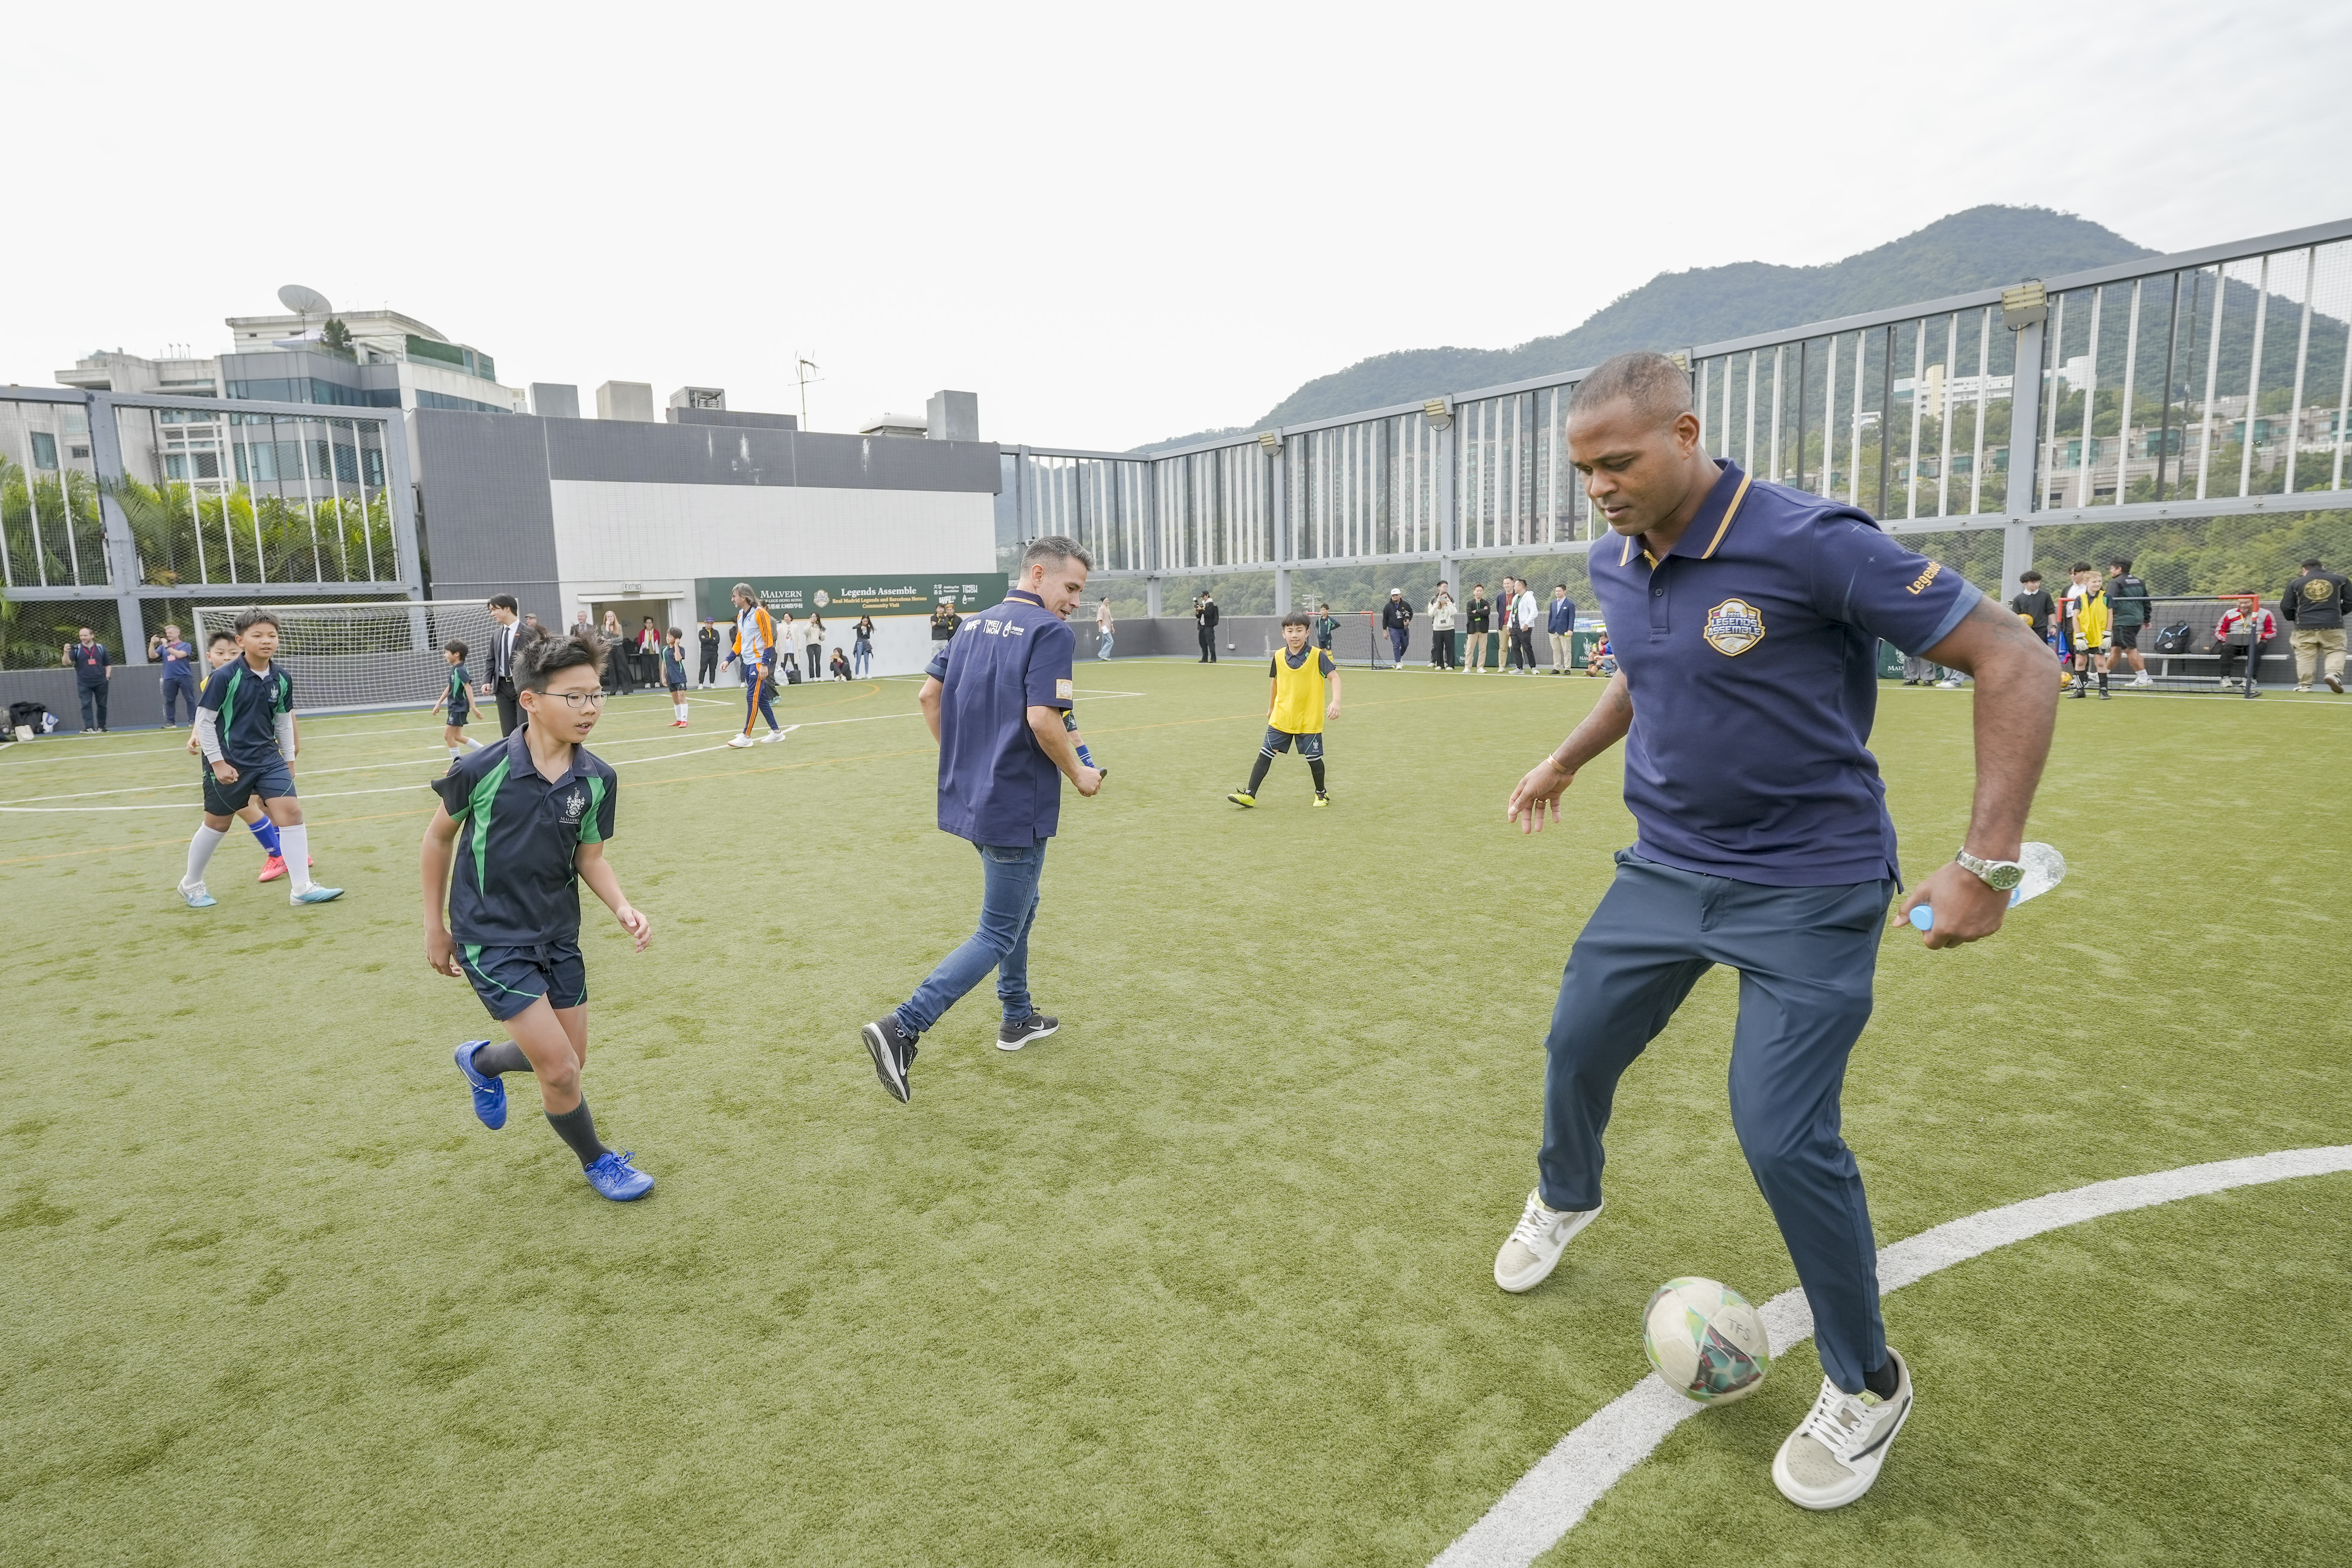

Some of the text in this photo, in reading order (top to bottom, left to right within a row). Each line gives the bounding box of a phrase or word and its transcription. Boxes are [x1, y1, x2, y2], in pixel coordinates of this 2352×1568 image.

[1906, 561, 1941, 594] Legends
[841, 587, 876, 598] Legends
[878, 586, 917, 595] Assemble
[1711, 618, 1758, 627] LEGENDS
[1707, 626, 1761, 636] ASSEMBLE
[1726, 1317, 1750, 1341] TFS
